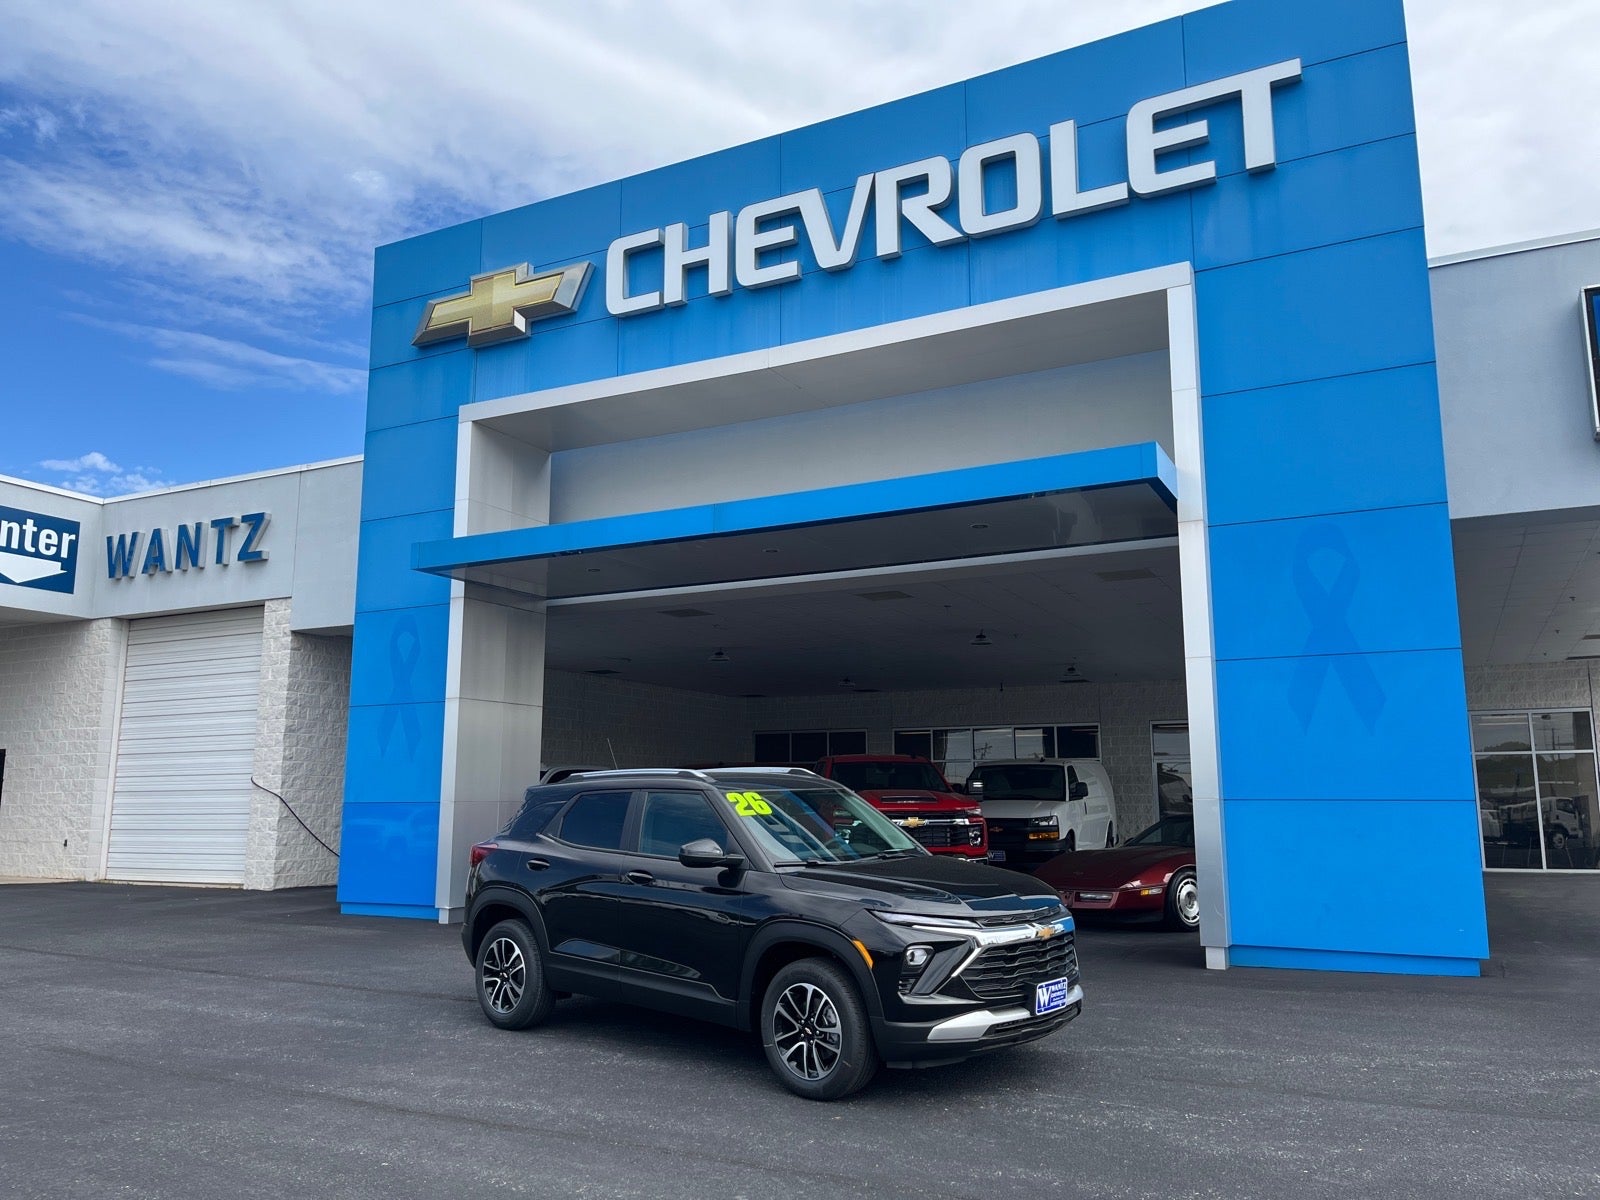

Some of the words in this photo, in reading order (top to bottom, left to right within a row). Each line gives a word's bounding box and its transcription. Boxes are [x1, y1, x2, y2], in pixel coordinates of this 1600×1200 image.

[605, 58, 1302, 318] CHEVROLET
[106, 512, 271, 579] WANTZ
[726, 792, 773, 816] 26
